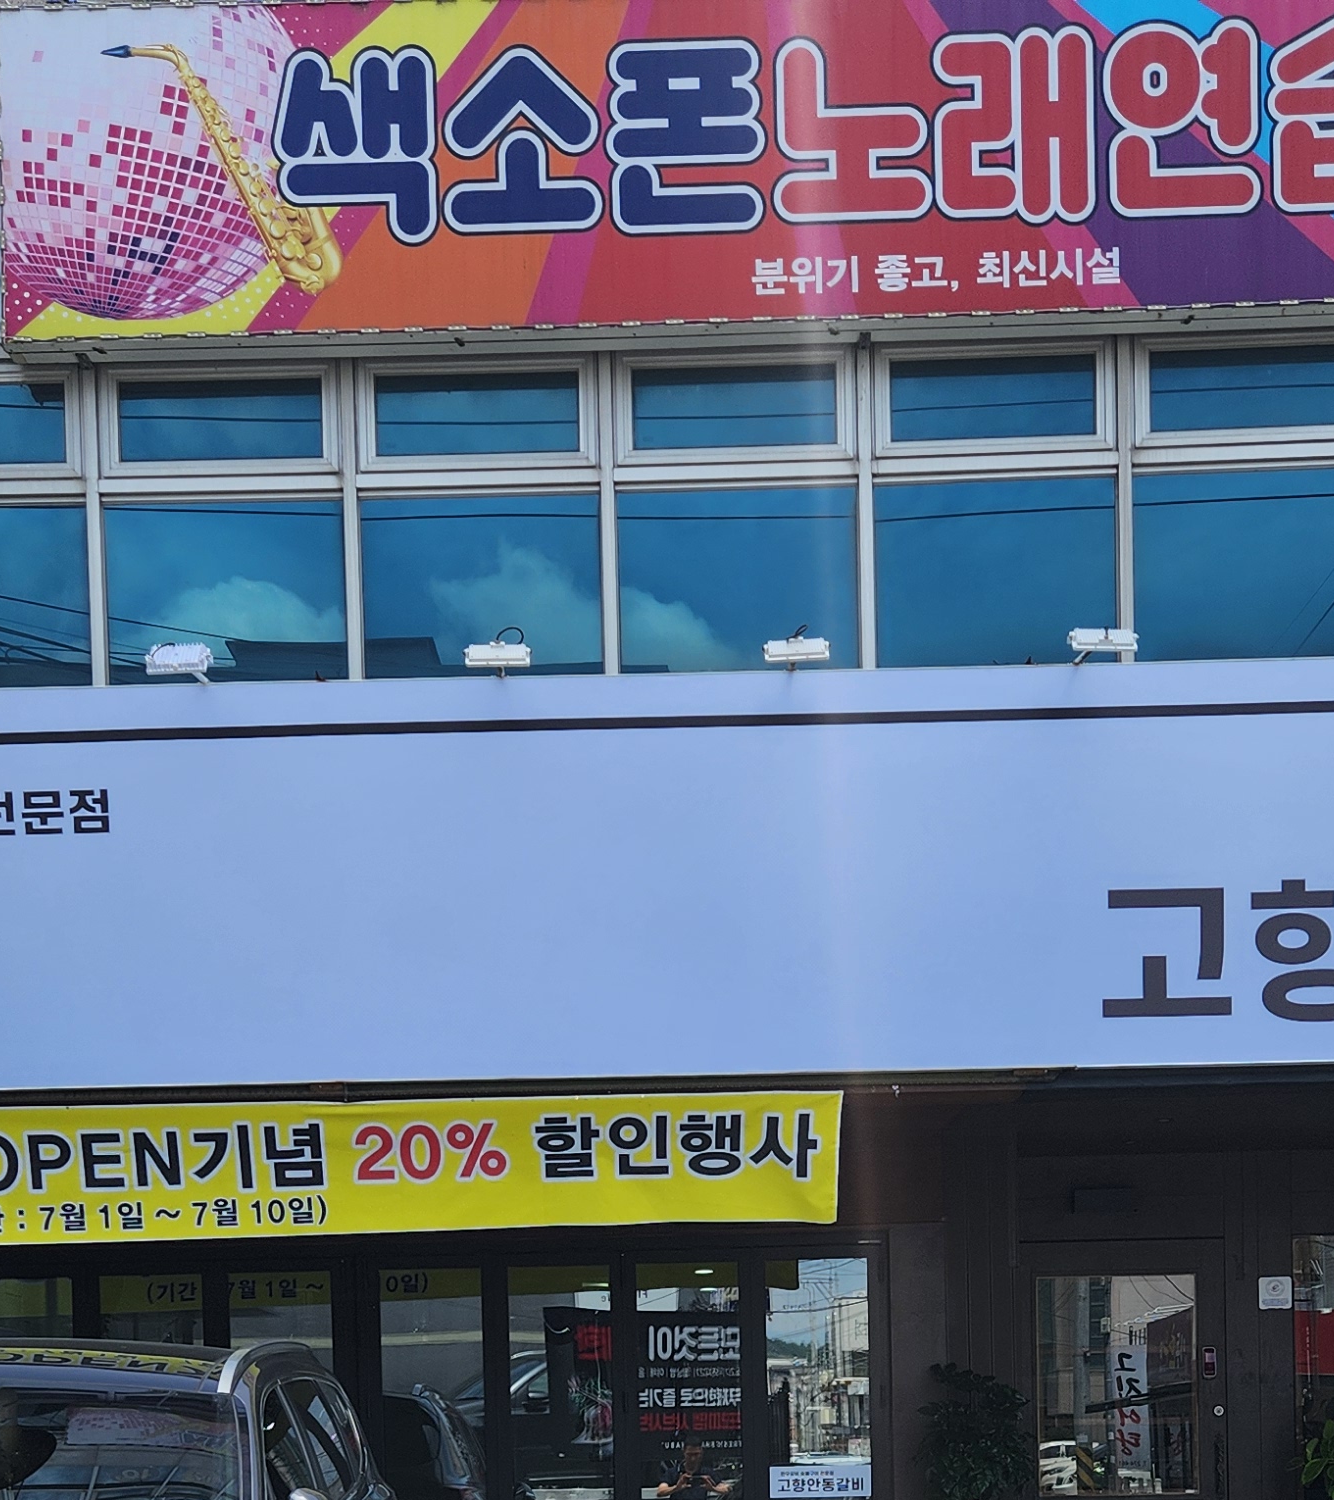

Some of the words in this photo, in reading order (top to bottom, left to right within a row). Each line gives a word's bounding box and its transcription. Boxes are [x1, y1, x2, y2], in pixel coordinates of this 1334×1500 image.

[751, 256, 859, 296] 분위기
[874, 254, 960, 292] 좋고,
[977, 246, 1121, 289] 최신시설
[354, 1121, 508, 1183] 20%
[535, 1110, 819, 1180] 할인행사
[39, 1202, 88, 1234] 7월
[98, 1201, 144, 1231] 1일
[190, 1197, 239, 1228] 7월
[777, 1477, 864, 1493] 고향안동갈비
